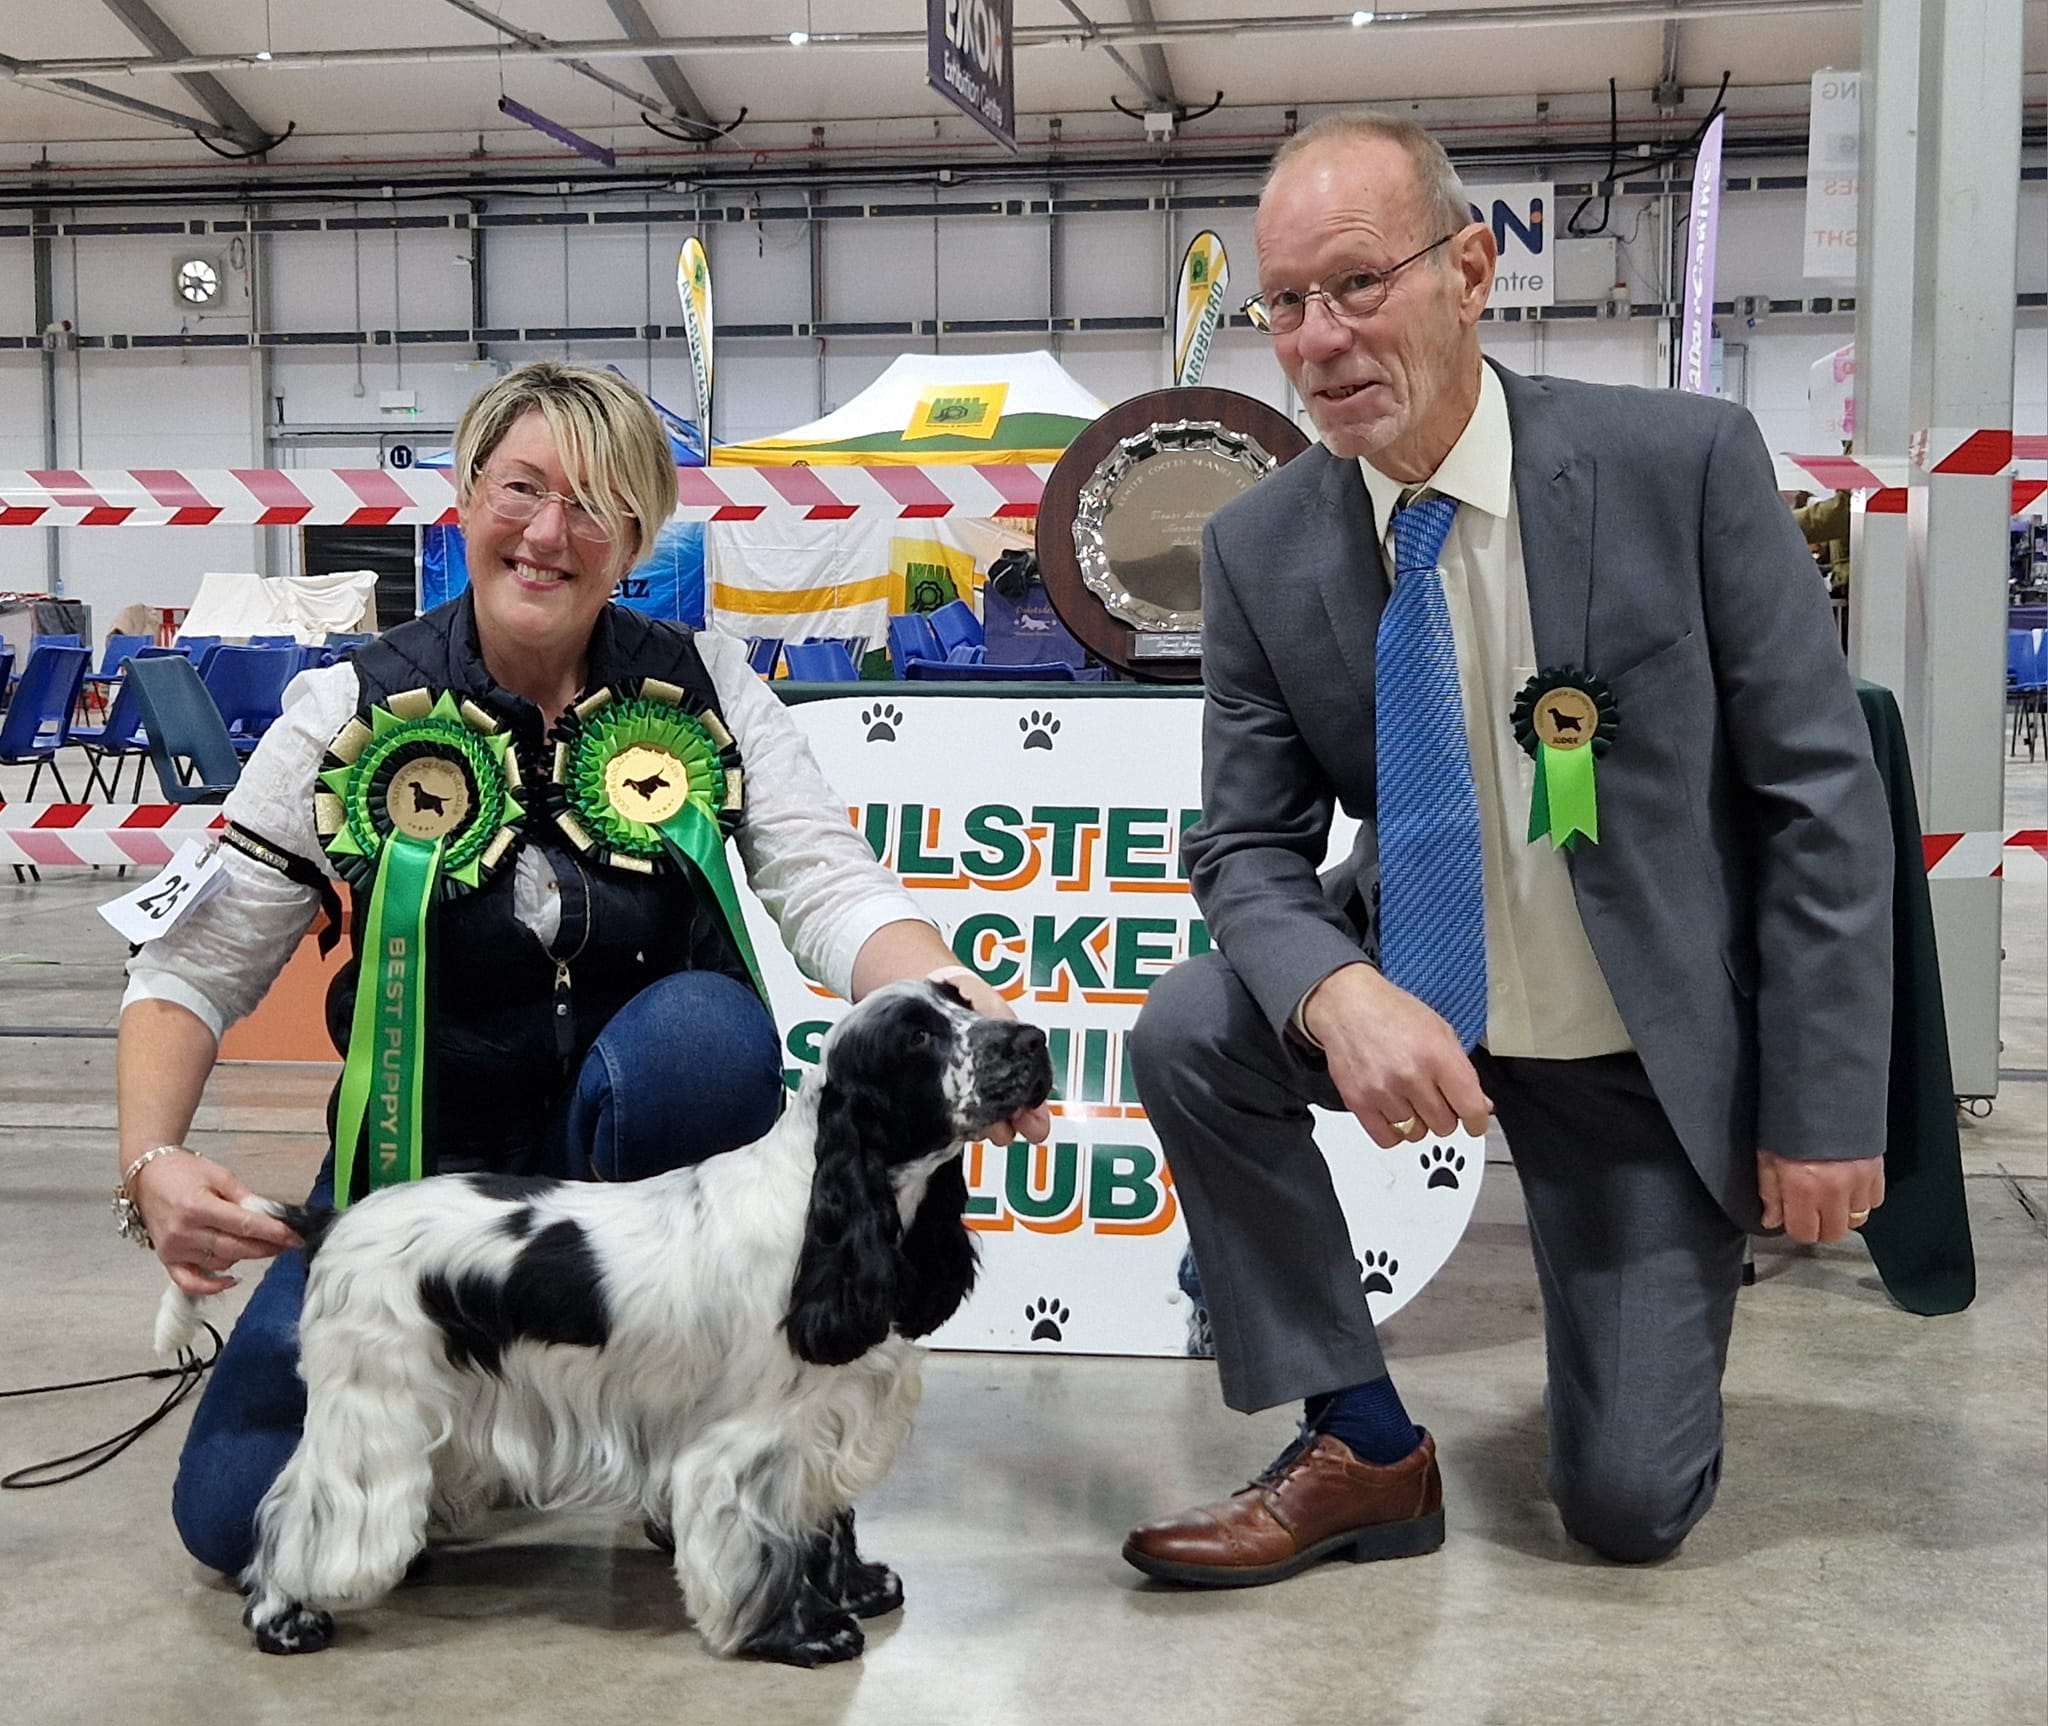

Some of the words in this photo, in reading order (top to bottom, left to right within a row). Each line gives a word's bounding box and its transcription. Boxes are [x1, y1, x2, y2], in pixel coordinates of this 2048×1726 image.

[1468, 198, 1543, 255] N
[136, 874, 190, 920] 25
[385, 937, 406, 1020] BEST
[932, 912, 1217, 990] CKE
[378, 1026, 402, 1136] PUPPY
